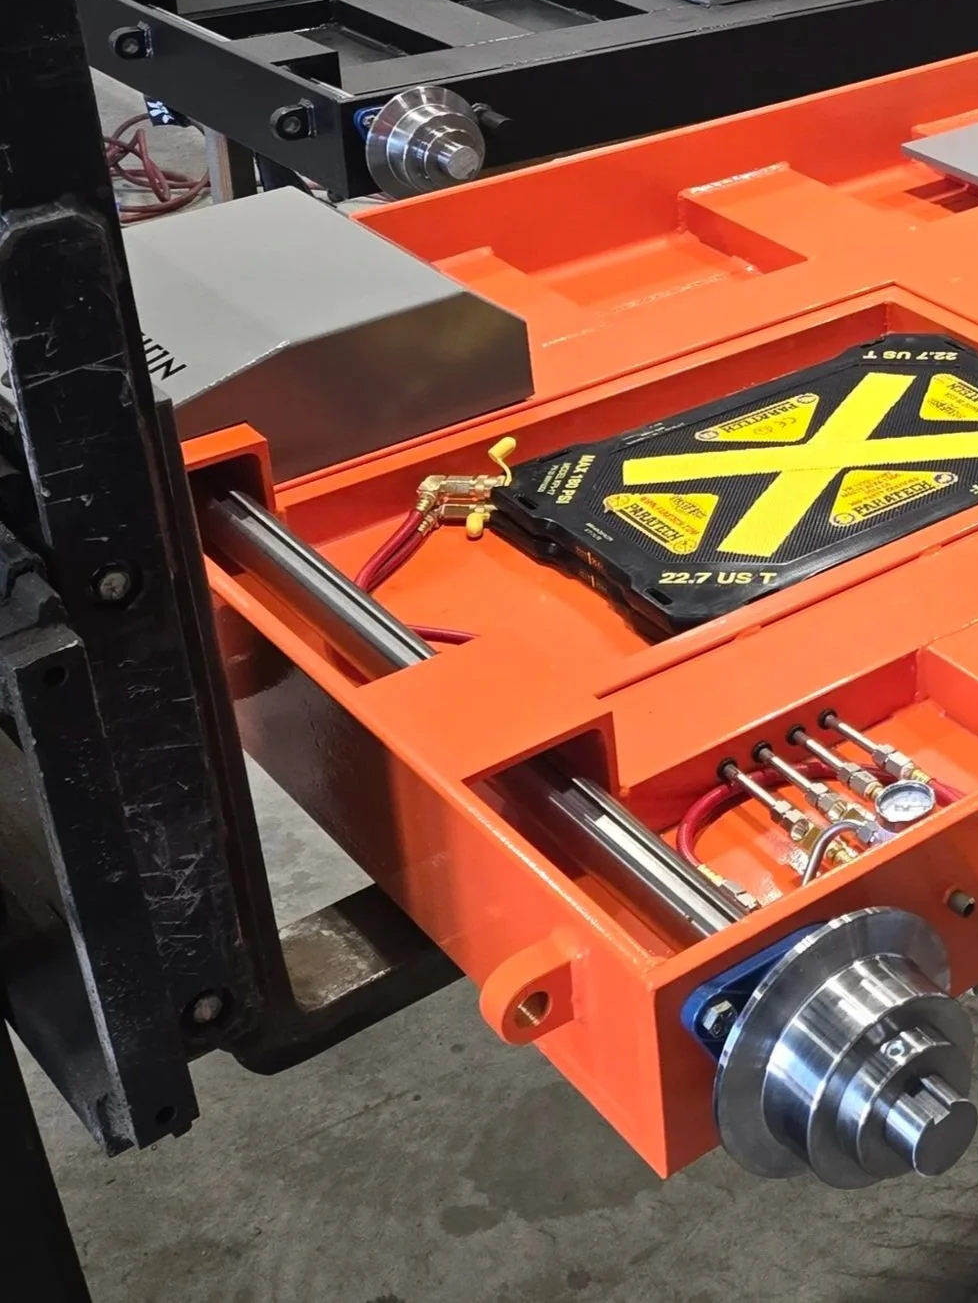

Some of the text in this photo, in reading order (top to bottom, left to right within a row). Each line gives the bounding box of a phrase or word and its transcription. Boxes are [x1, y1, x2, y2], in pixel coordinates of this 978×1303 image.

[862, 349, 958, 361] 22.7 US T
[720, 400, 799, 434] PARATECH
[573, 454, 596, 473] MAX
[555, 489, 576, 504] PSI
[853, 480, 932, 515] PARATECH
[624, 502, 684, 541] PARATECH
[658, 572, 777, 585] 22.7 US T
